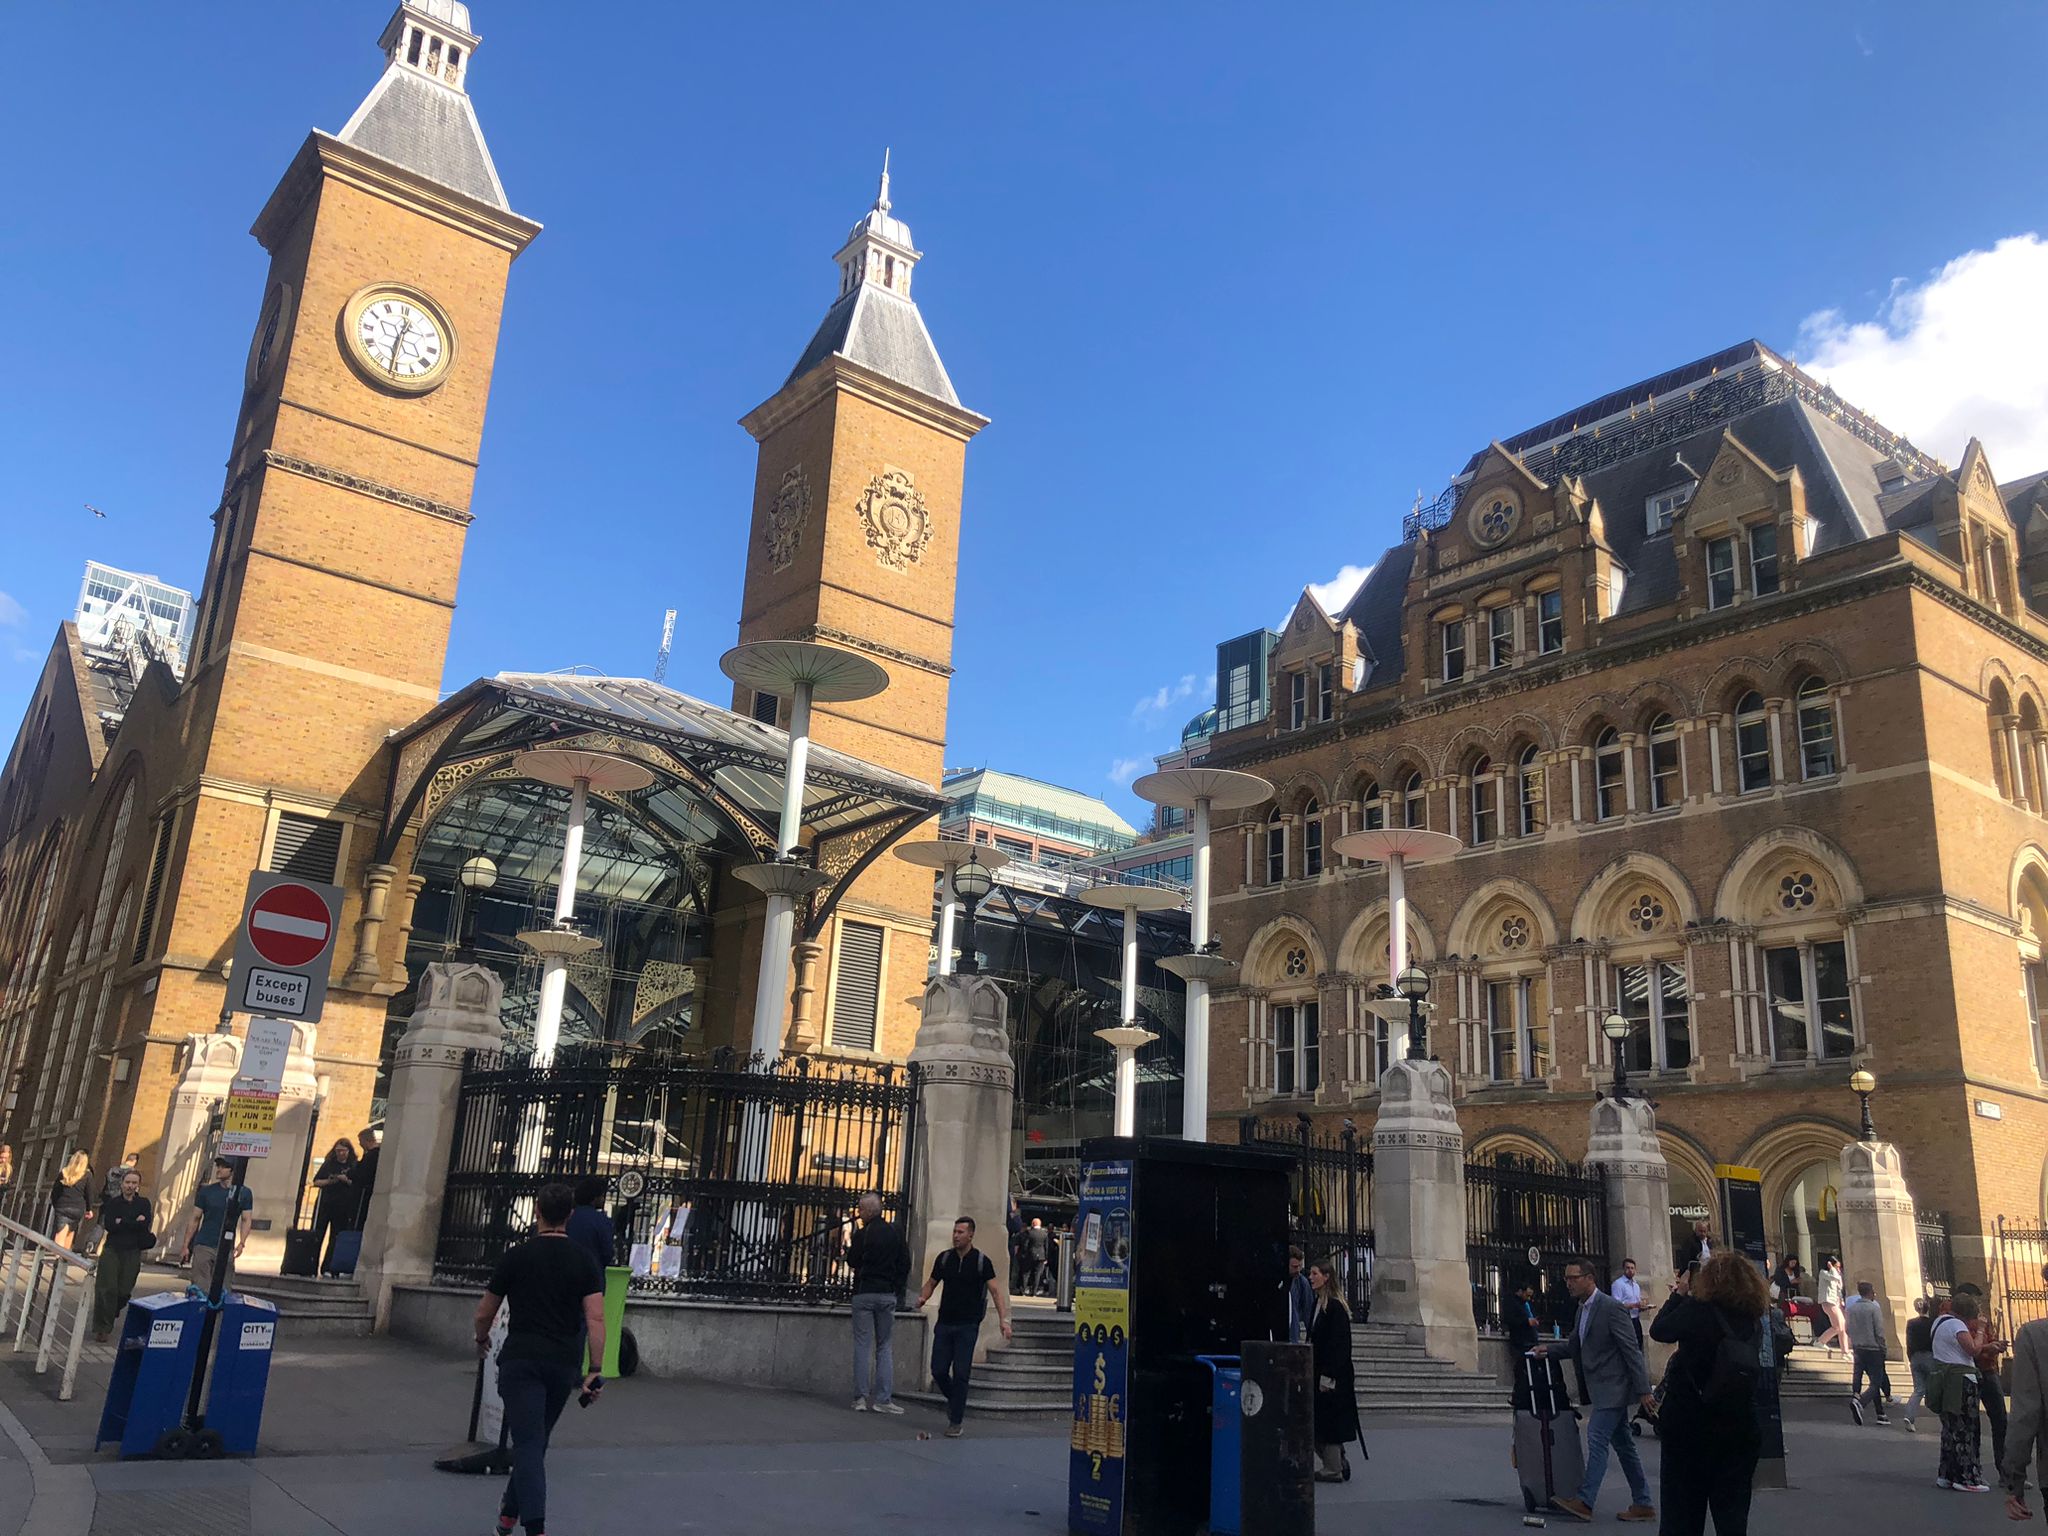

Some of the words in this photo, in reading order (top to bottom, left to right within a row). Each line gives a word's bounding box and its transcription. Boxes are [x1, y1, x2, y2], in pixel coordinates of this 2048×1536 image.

[256, 974, 303, 993] Except
[256, 990, 296, 1006] buses
[1106, 1186, 1118, 1194] VISIT
[1119, 1186, 1127, 1194] US
[1668, 1205, 1710, 1216] onald's
